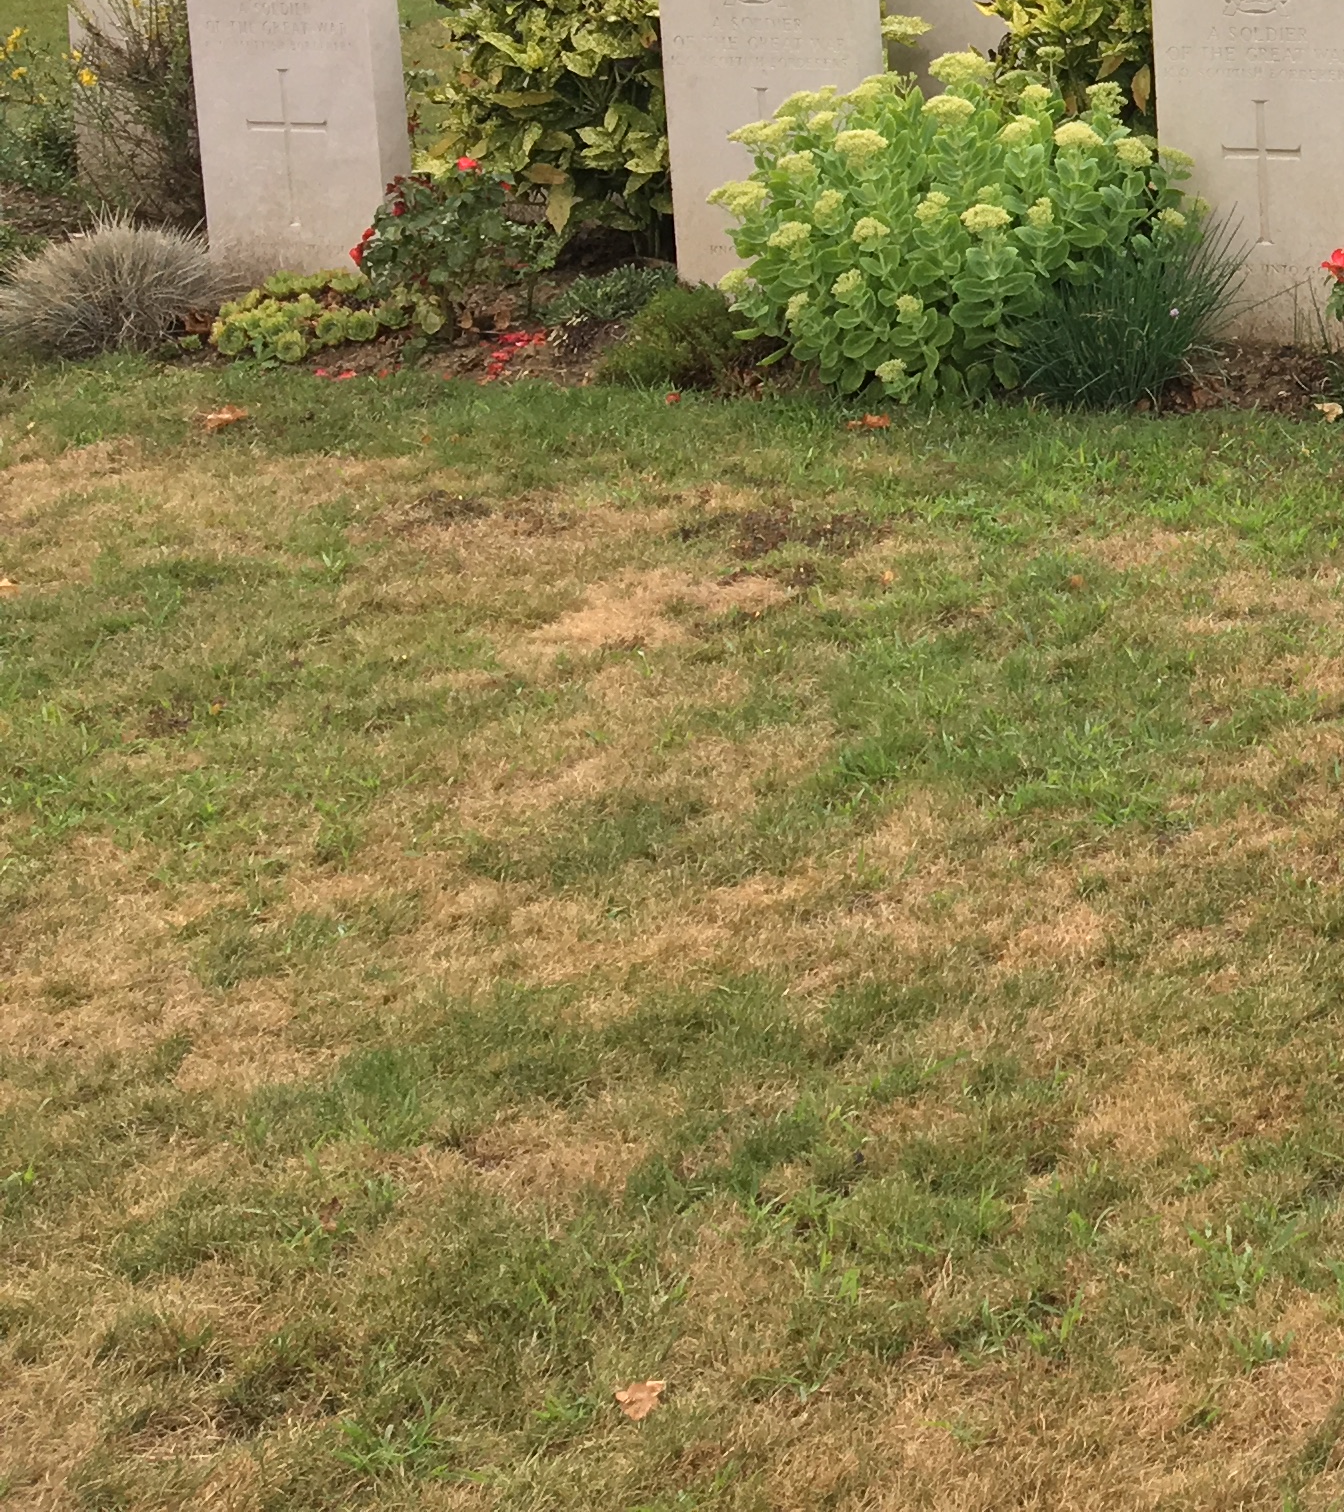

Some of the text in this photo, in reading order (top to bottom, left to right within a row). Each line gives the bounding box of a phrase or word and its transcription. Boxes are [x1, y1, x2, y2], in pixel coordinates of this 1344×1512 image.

[1208, 26, 1309, 43] A SOLDIER
[1166, 46, 1193, 62] OF
[1200, 46, 1237, 63] THE
[1246, 47, 1306, 64] GREAT
